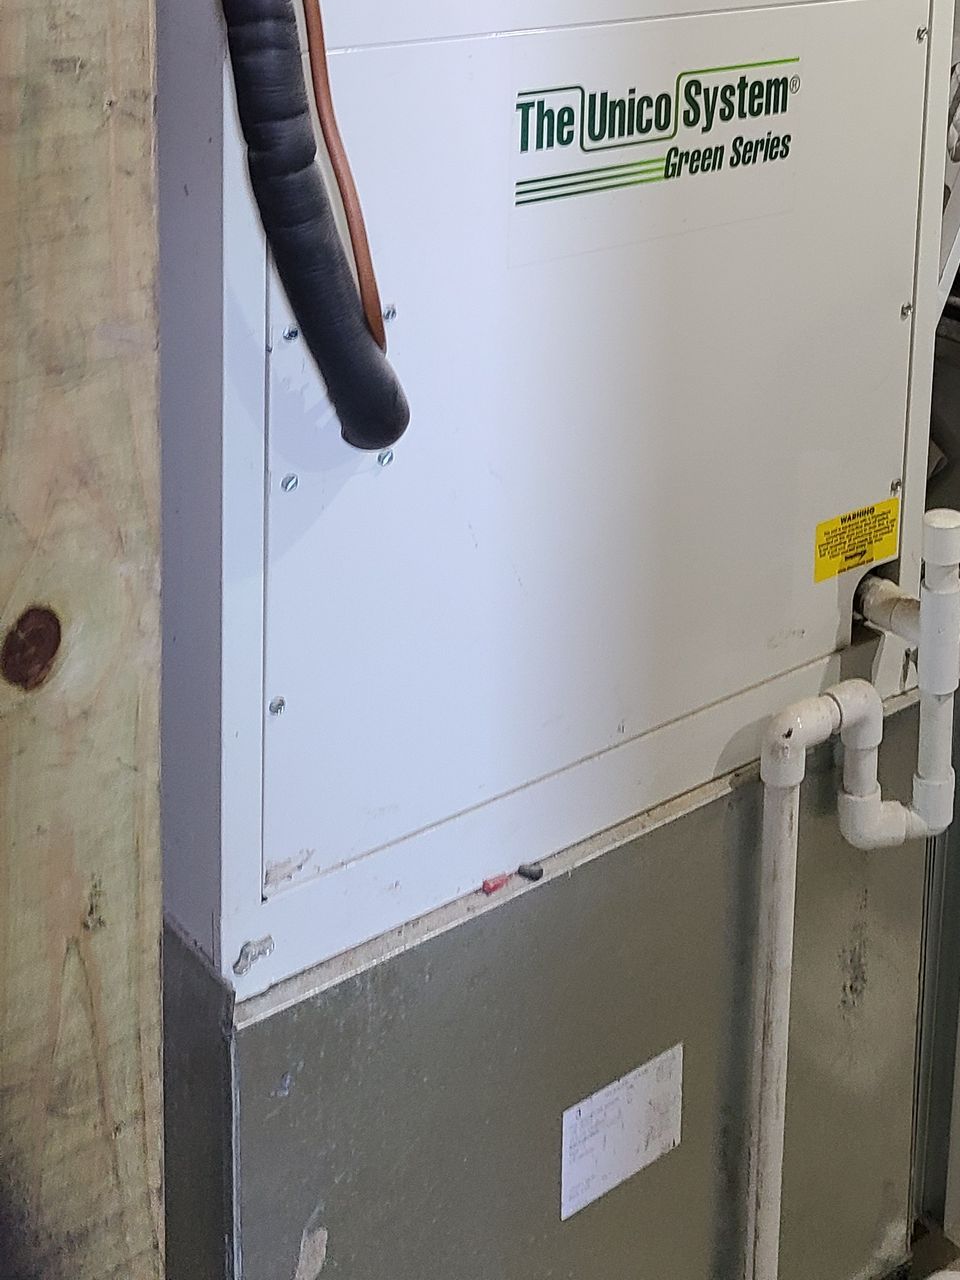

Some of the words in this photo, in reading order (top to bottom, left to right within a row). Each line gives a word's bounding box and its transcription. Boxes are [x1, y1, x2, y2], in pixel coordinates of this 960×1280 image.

[516, 99, 575, 153] The
[588, 88, 671, 141] Unico
[664, 145, 724, 179] Green
[729, 131, 792, 168] Series
